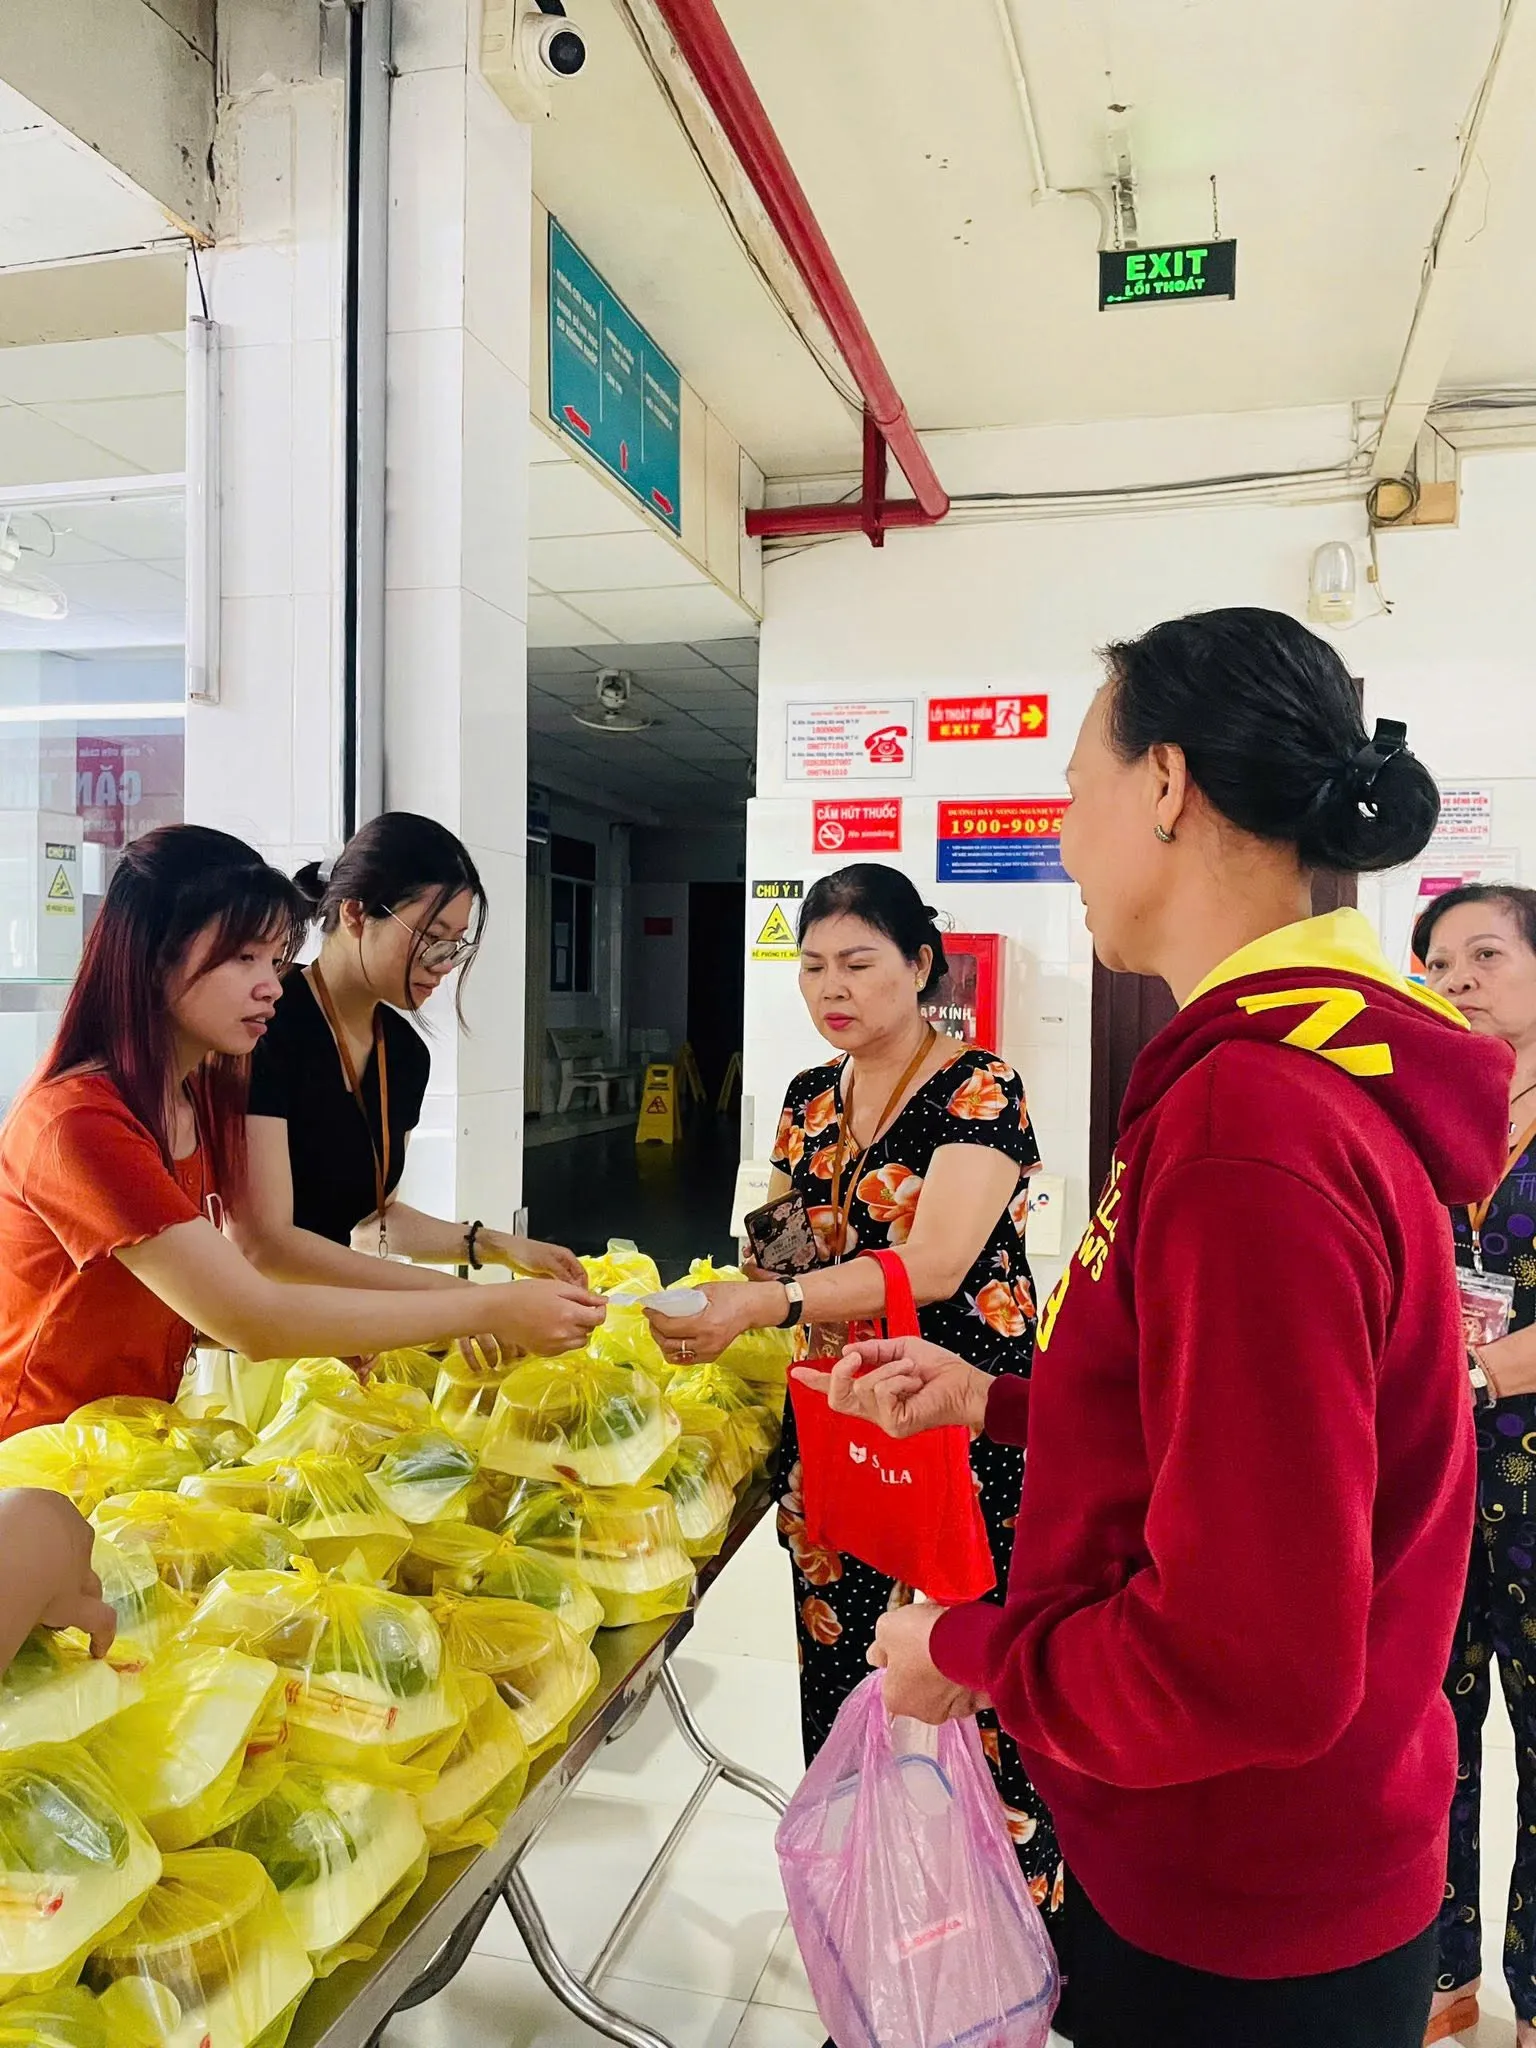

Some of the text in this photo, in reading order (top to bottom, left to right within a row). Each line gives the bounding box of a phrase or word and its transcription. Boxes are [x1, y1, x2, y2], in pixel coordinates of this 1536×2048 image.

[1127, 249, 1208, 280] EXIT
[1125, 276, 1205, 296] LỐI THOÁT
[940, 723, 980, 737] EXIT
[817, 802, 897, 820] CẤM HÚT THUỐC
[951, 818, 1061, 834] 1900-9095
[756, 882, 779, 898] CHÚ
[782, 882, 790, 898] Ý
[939, 1003, 971, 1020] KÍNH
